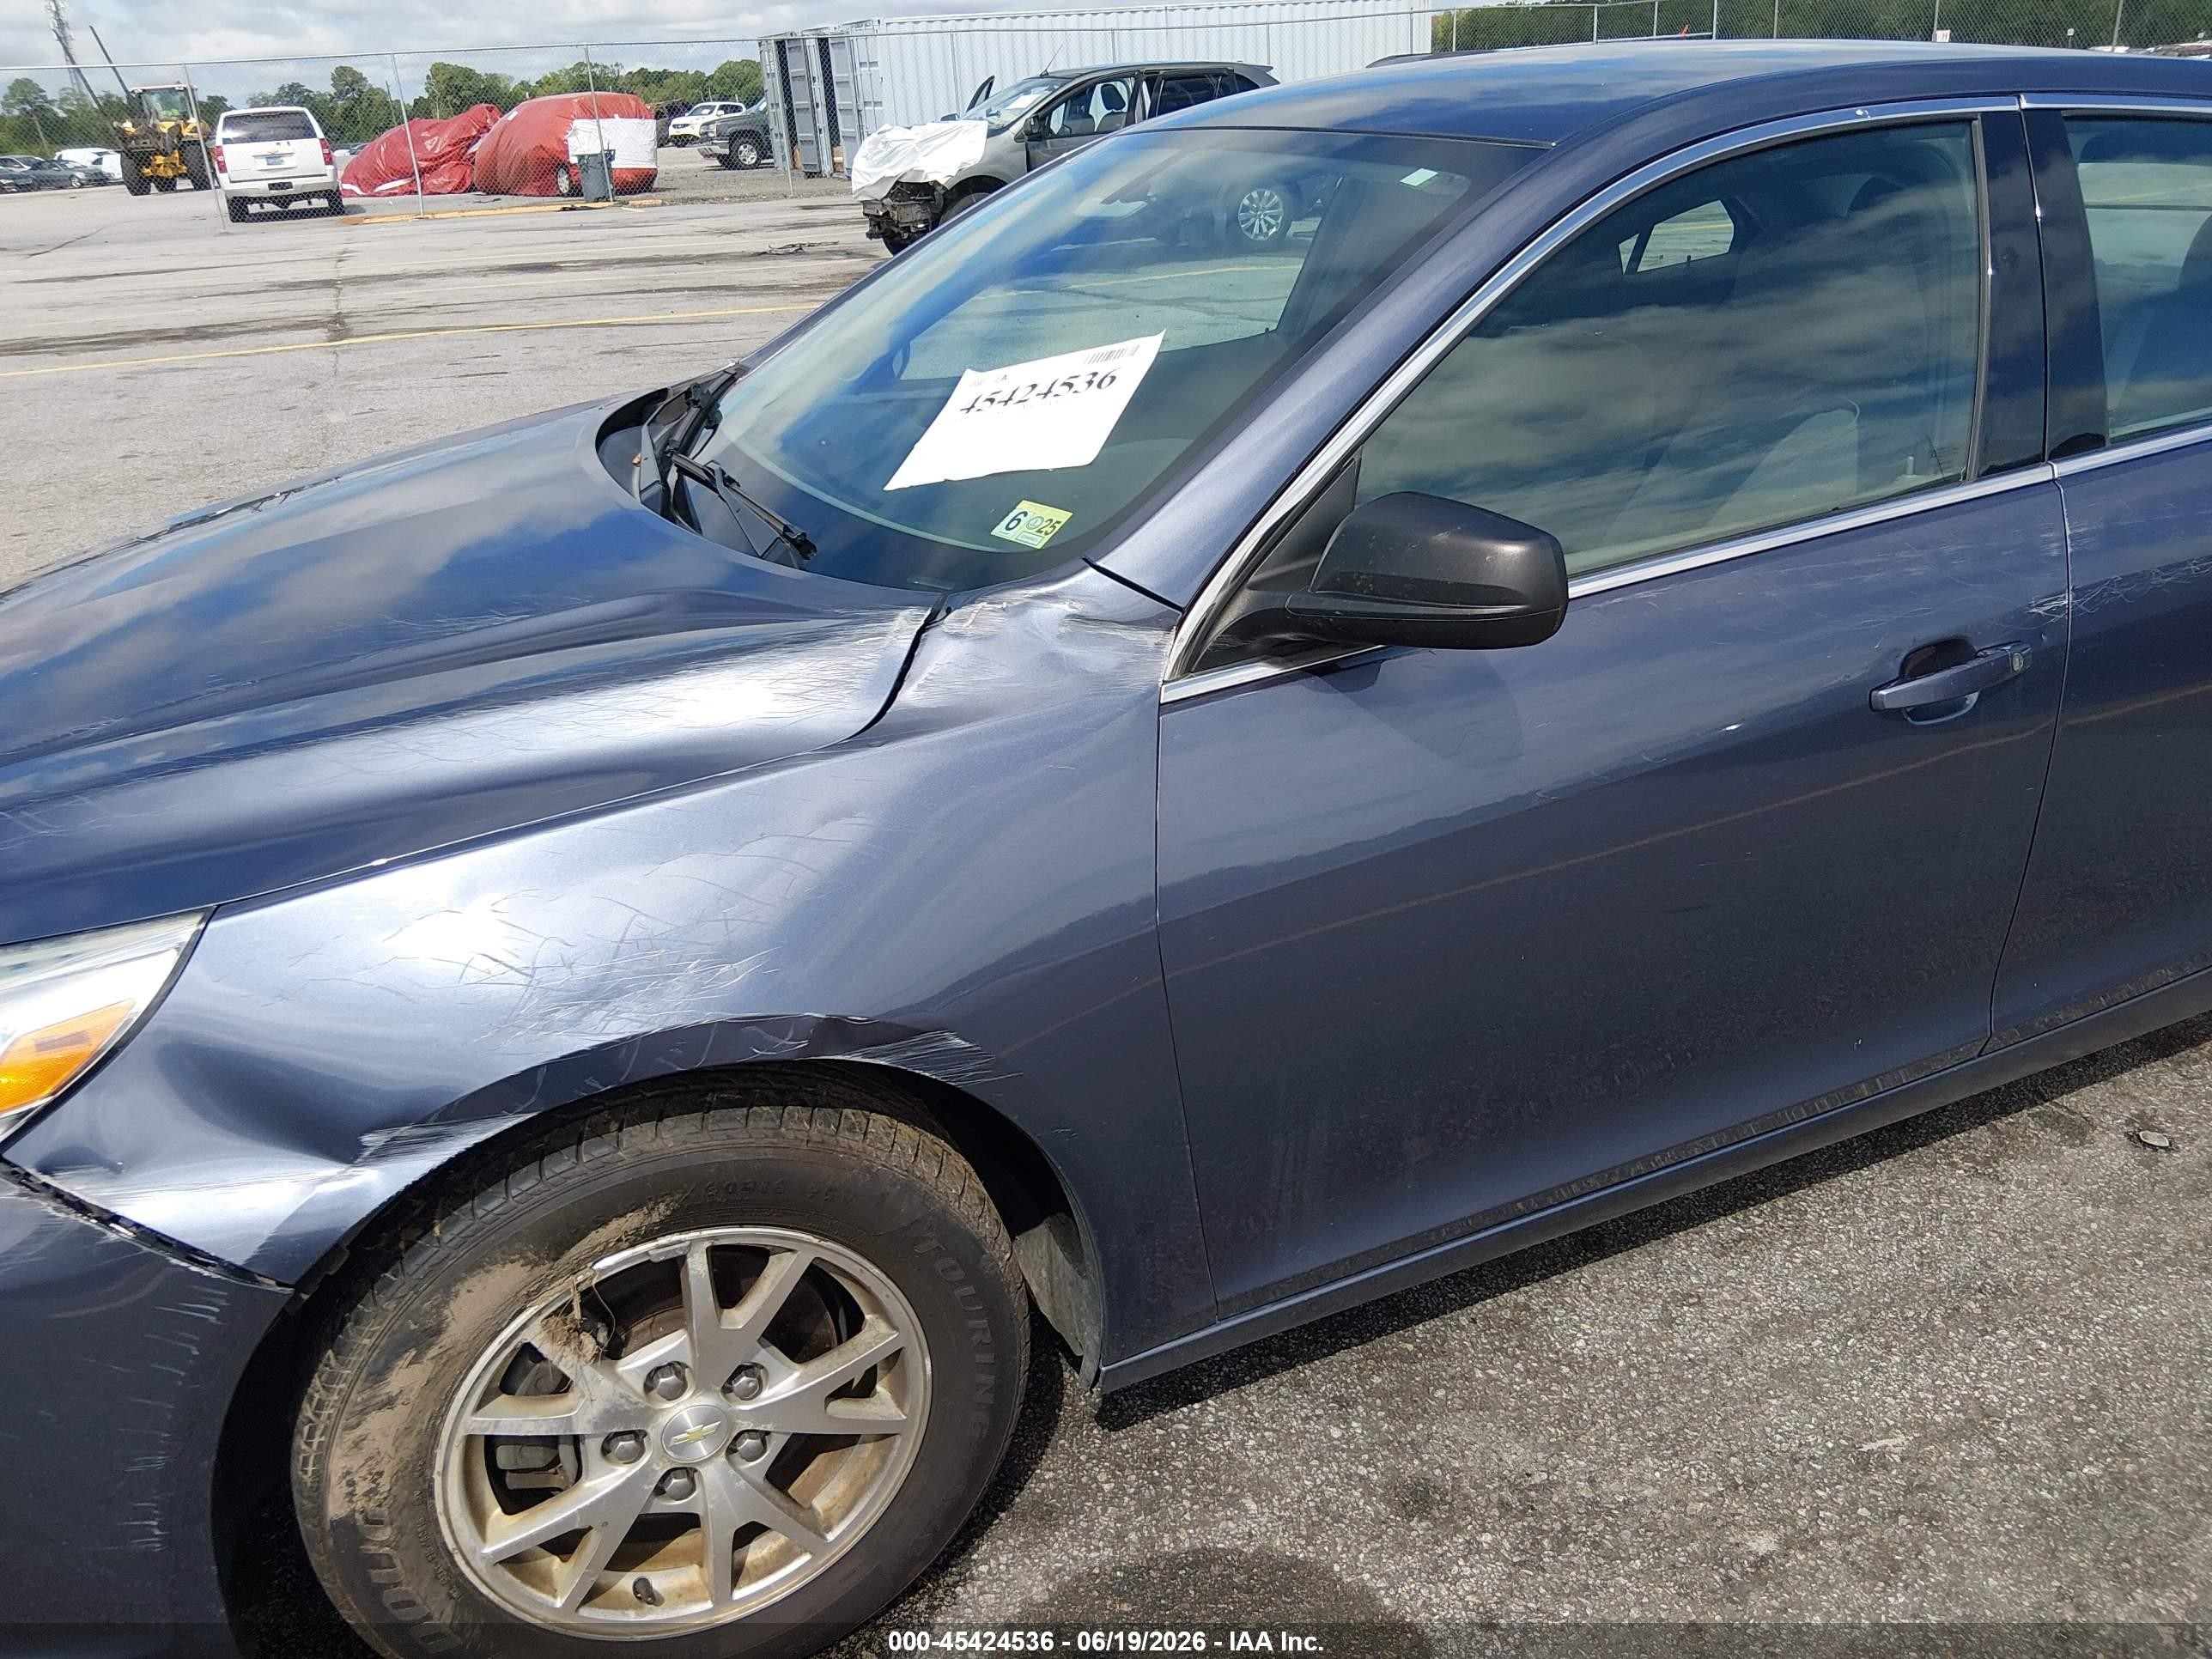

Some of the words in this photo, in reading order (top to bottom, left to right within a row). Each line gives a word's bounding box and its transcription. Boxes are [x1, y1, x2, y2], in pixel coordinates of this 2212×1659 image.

[959, 367, 1123, 414] 45424536
[1005, 511, 1028, 531] 6
[1036, 518, 1062, 536] 25
